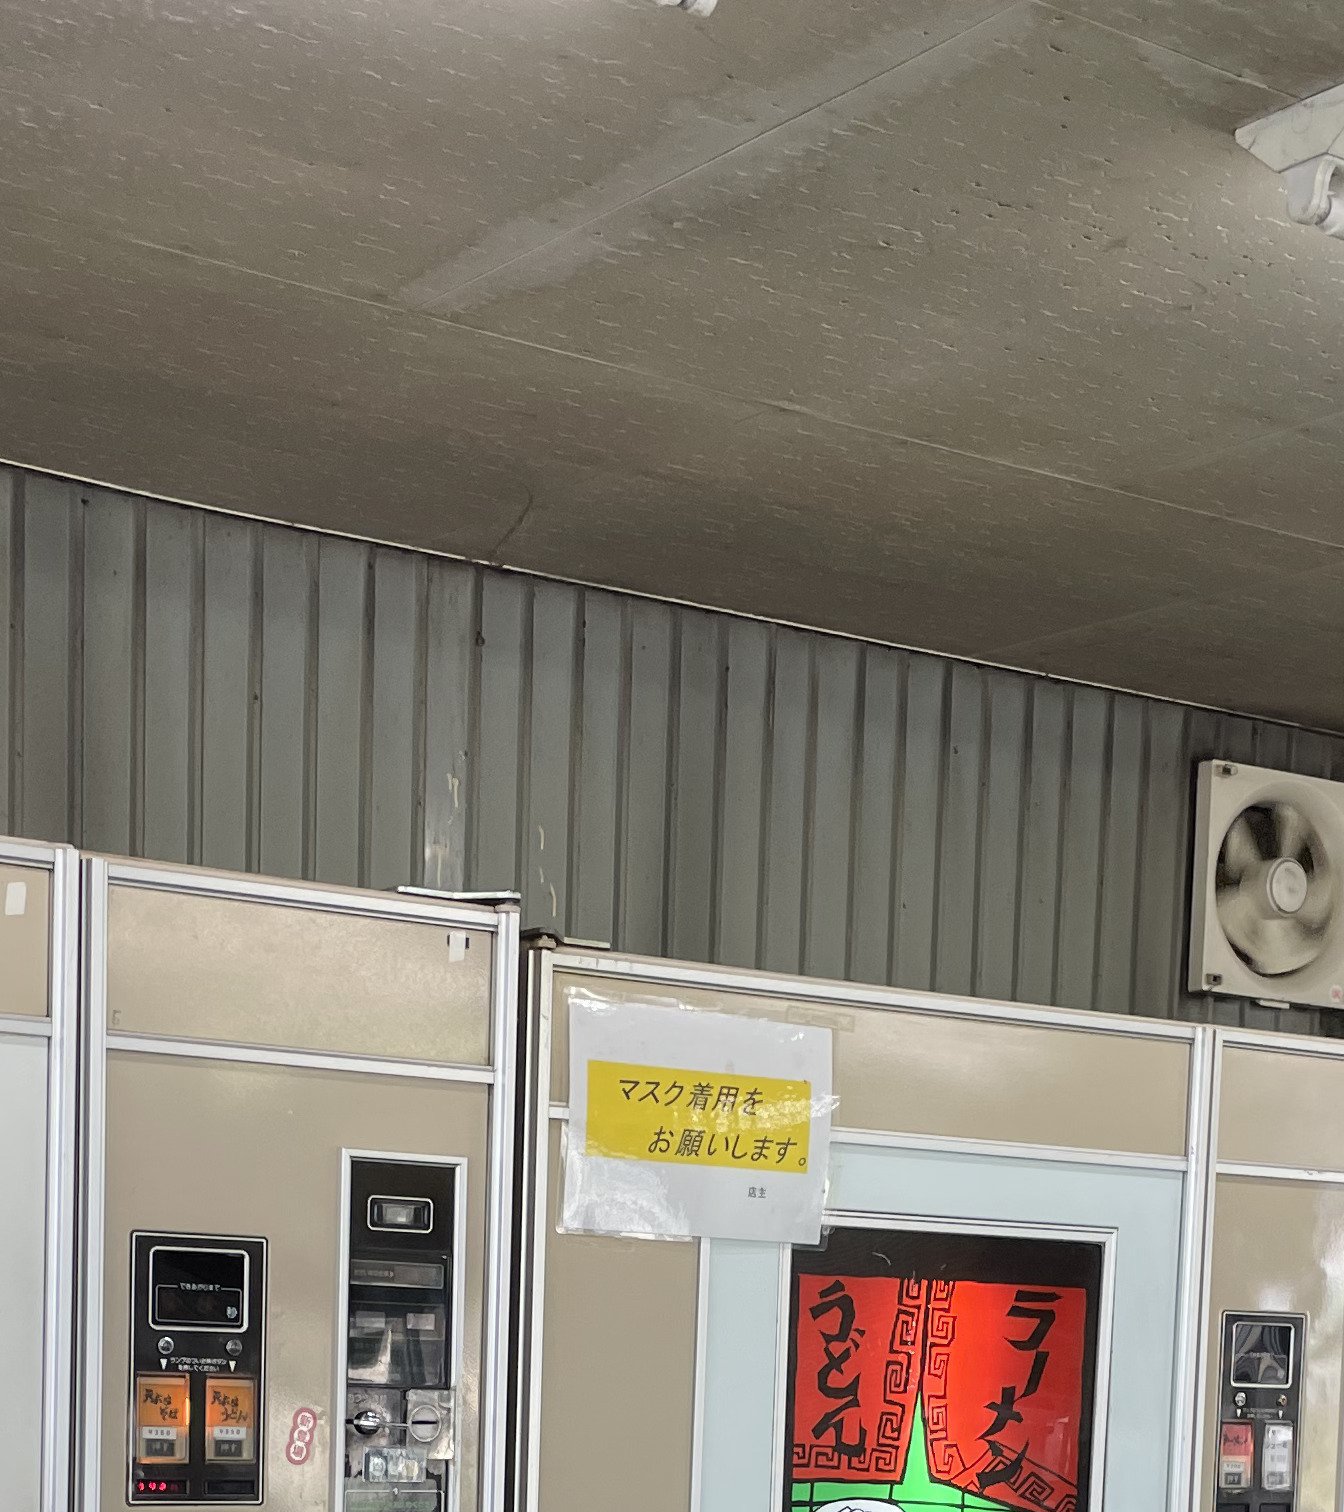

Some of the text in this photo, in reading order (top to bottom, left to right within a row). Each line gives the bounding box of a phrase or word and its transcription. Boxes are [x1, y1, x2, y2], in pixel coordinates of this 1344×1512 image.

[619, 1078, 764, 1116] マスク着用を
[648, 1126, 806, 1166] お願いします。
[747, 1186, 767, 1199] 店主
[809, 1280, 866, 1457] うどん
[976, 1290, 1062, 1489] ラーメン
